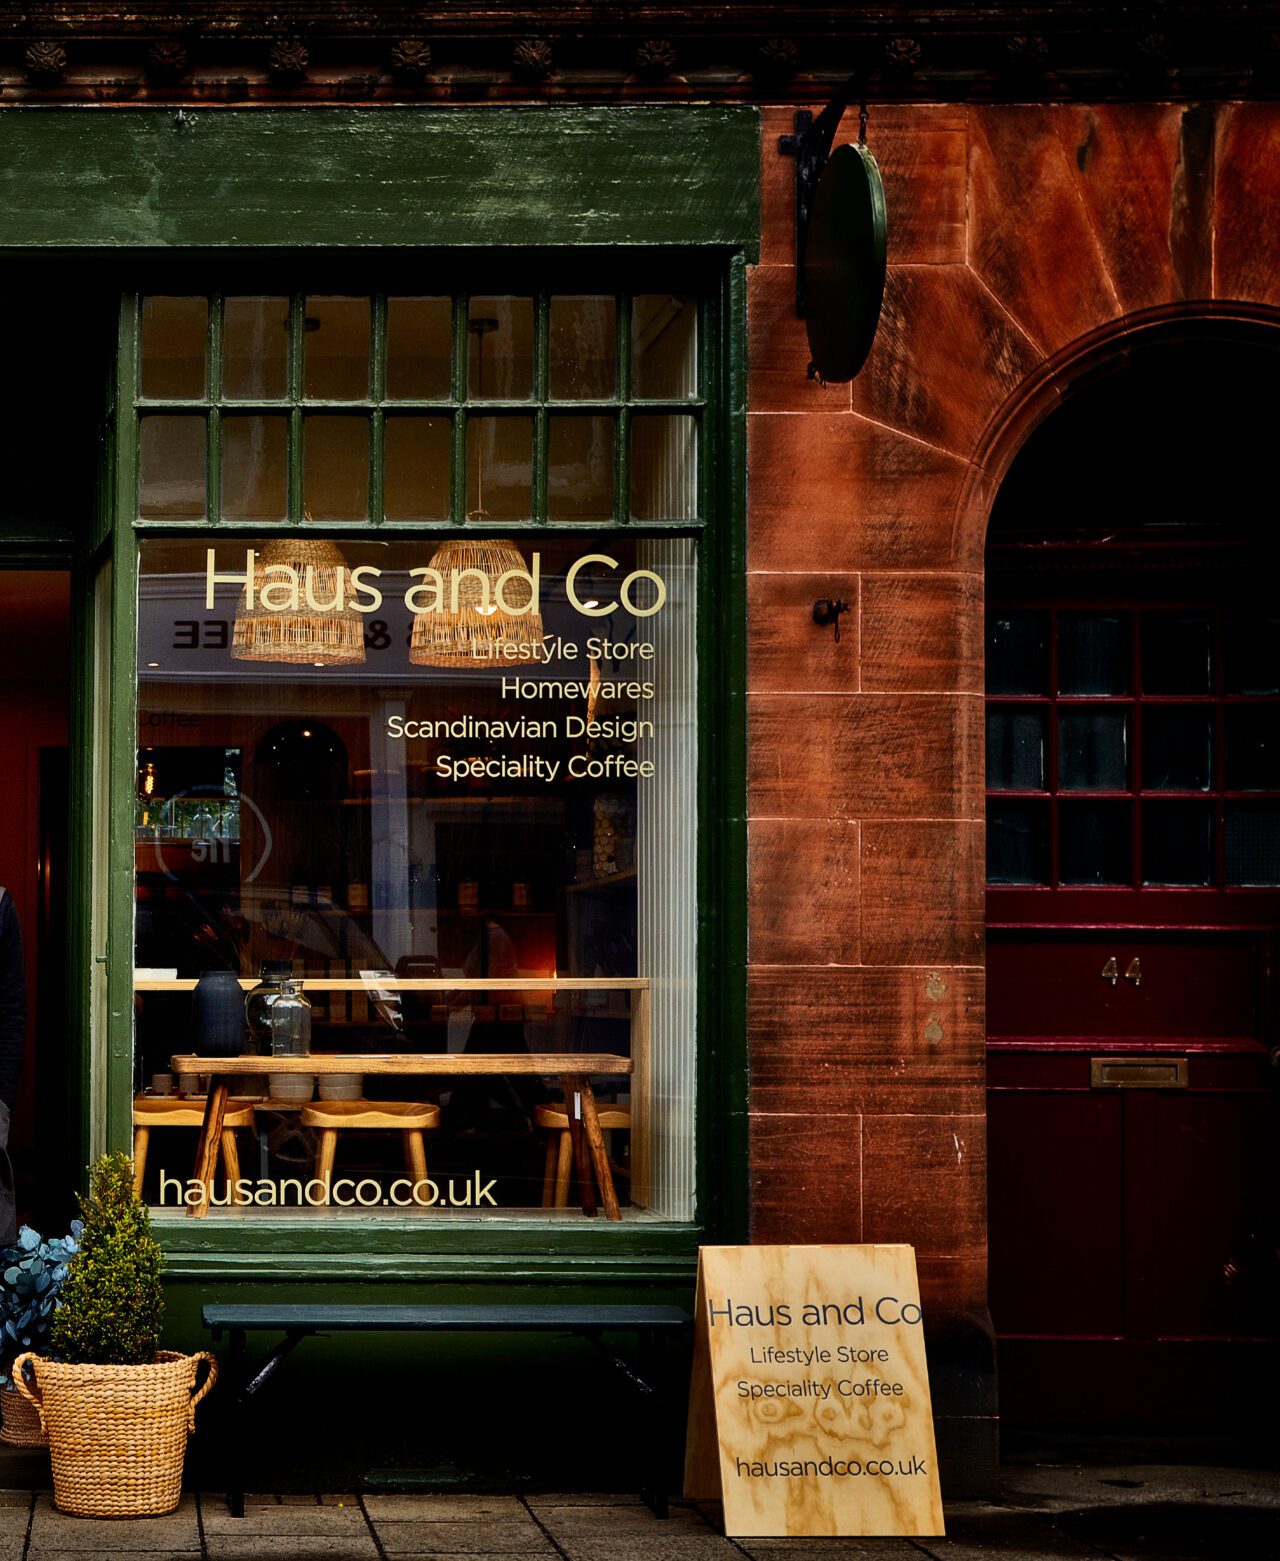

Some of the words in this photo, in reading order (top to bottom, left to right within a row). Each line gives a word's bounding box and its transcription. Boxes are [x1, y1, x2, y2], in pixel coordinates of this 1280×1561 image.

[206, 548, 383, 612] Haus
[403, 551, 540, 616] and
[565, 553, 667, 618] Co
[470, 635, 578, 664] Lifestyle
[586, 637, 654, 660] Store
[501, 675, 654, 699] Homewares
[387, 715, 557, 738] Scandinavian
[566, 716, 654, 743] Design
[436, 754, 560, 782] Speciality
[568, 754, 655, 778] Coffee
[1101, 956, 1142, 987] 44
[158, 1169, 497, 1207] hausandco.co.uk
[707, 1298, 792, 1327] Haus
[802, 1296, 865, 1326] and
[875, 1296, 922, 1325] Co
[750, 1346, 831, 1366] Lifestyle
[837, 1346, 889, 1363] Store
[737, 1380, 831, 1400] Speciality
[837, 1379, 903, 1397] Coffee
[736, 1455, 927, 1477] hausandco.co.uk
